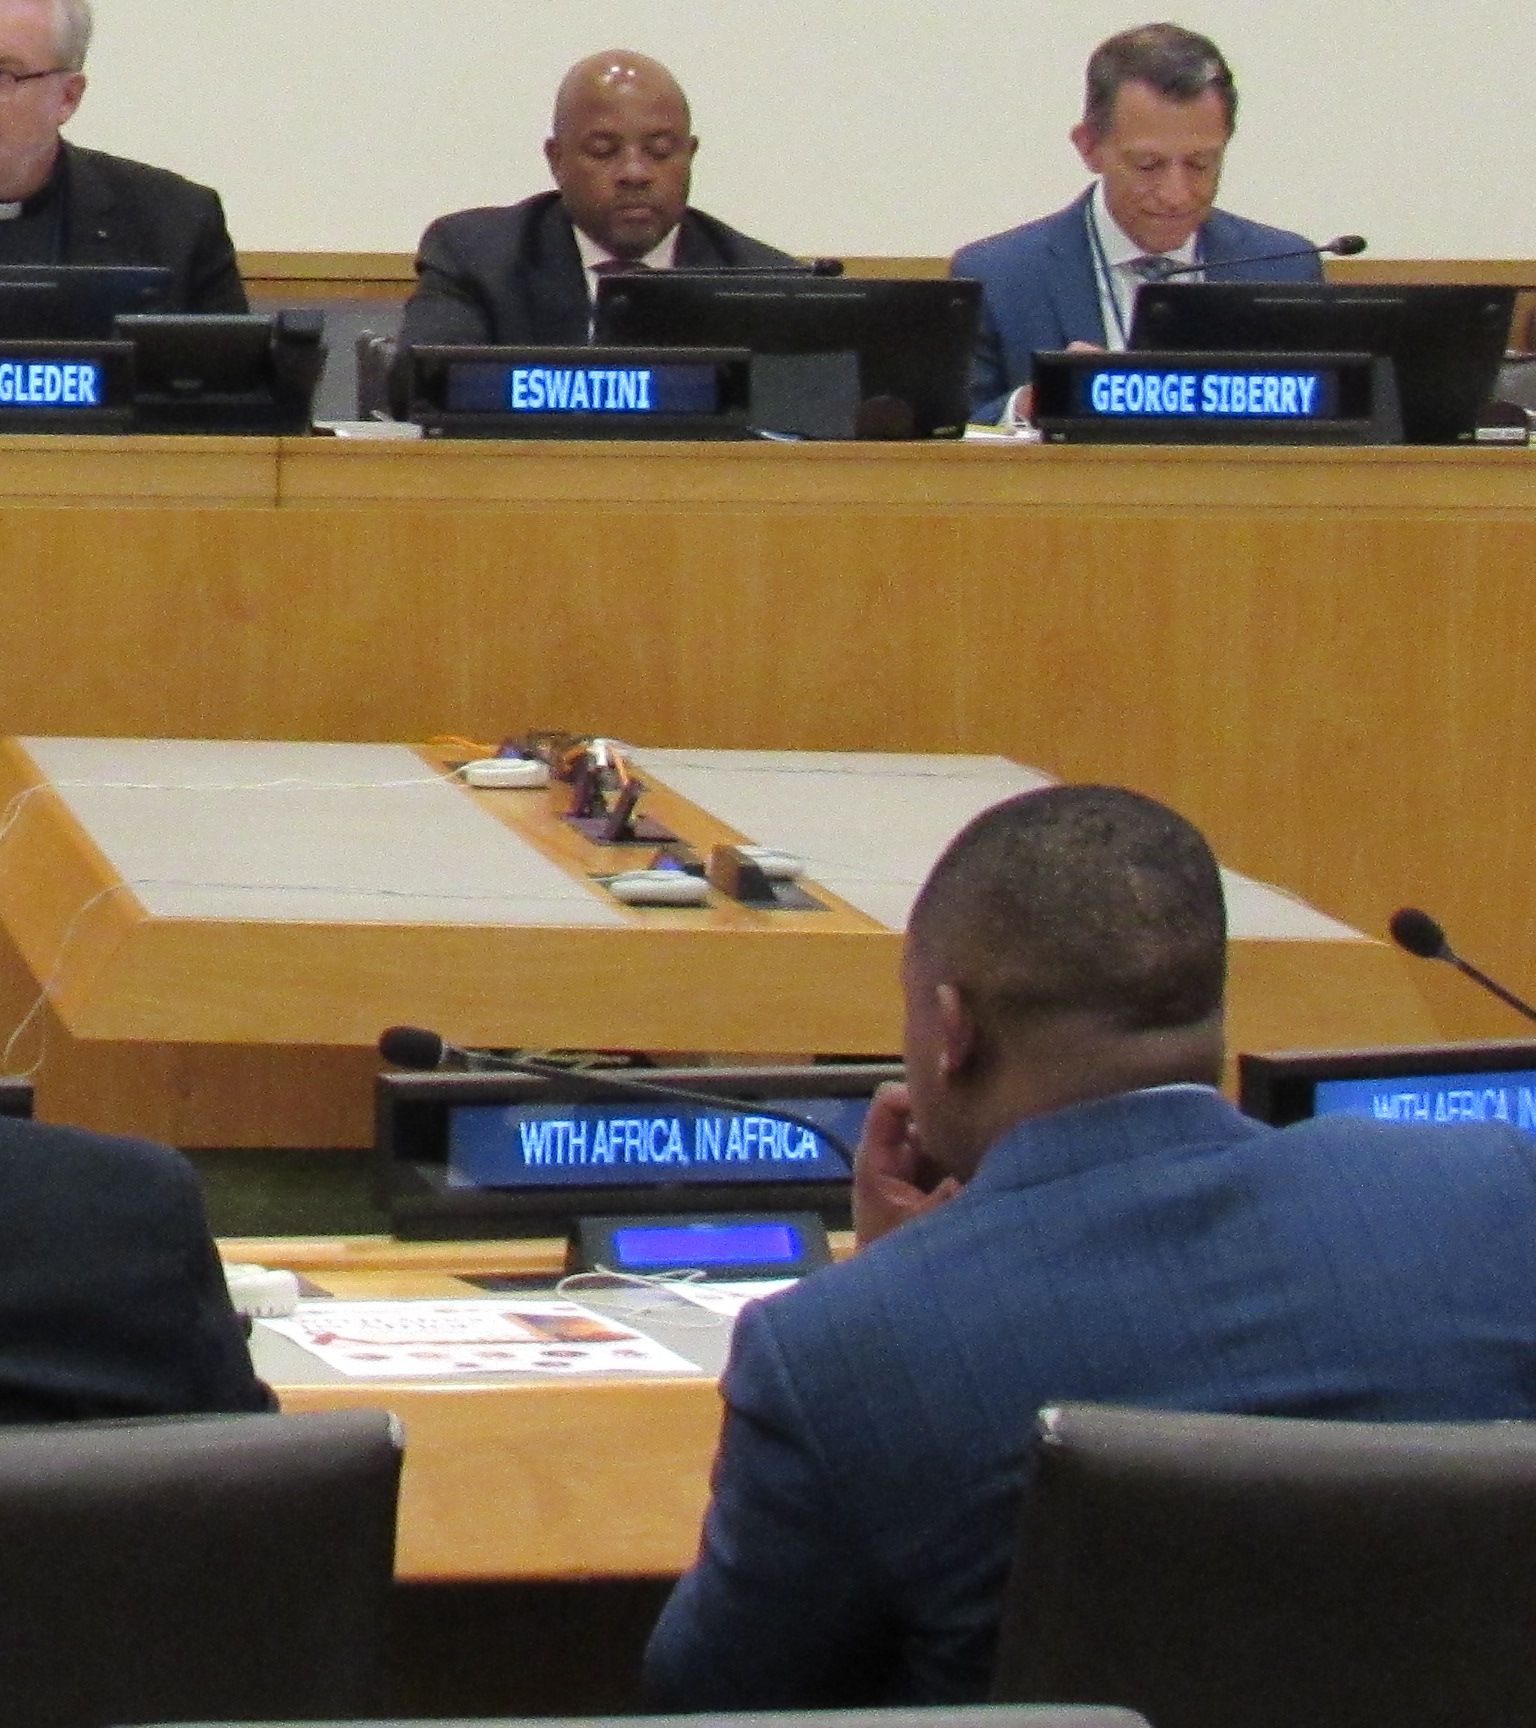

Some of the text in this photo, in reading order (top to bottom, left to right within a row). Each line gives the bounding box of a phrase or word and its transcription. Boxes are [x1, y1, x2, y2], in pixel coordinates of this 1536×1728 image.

[511, 369, 651, 410] ESWATINI
[1091, 373, 1316, 414] GEORGE SIBERRY
[520, 1121, 588, 1164] WITH
[694, 1117, 721, 1161] IN
[725, 1116, 819, 1159] AFRICA
